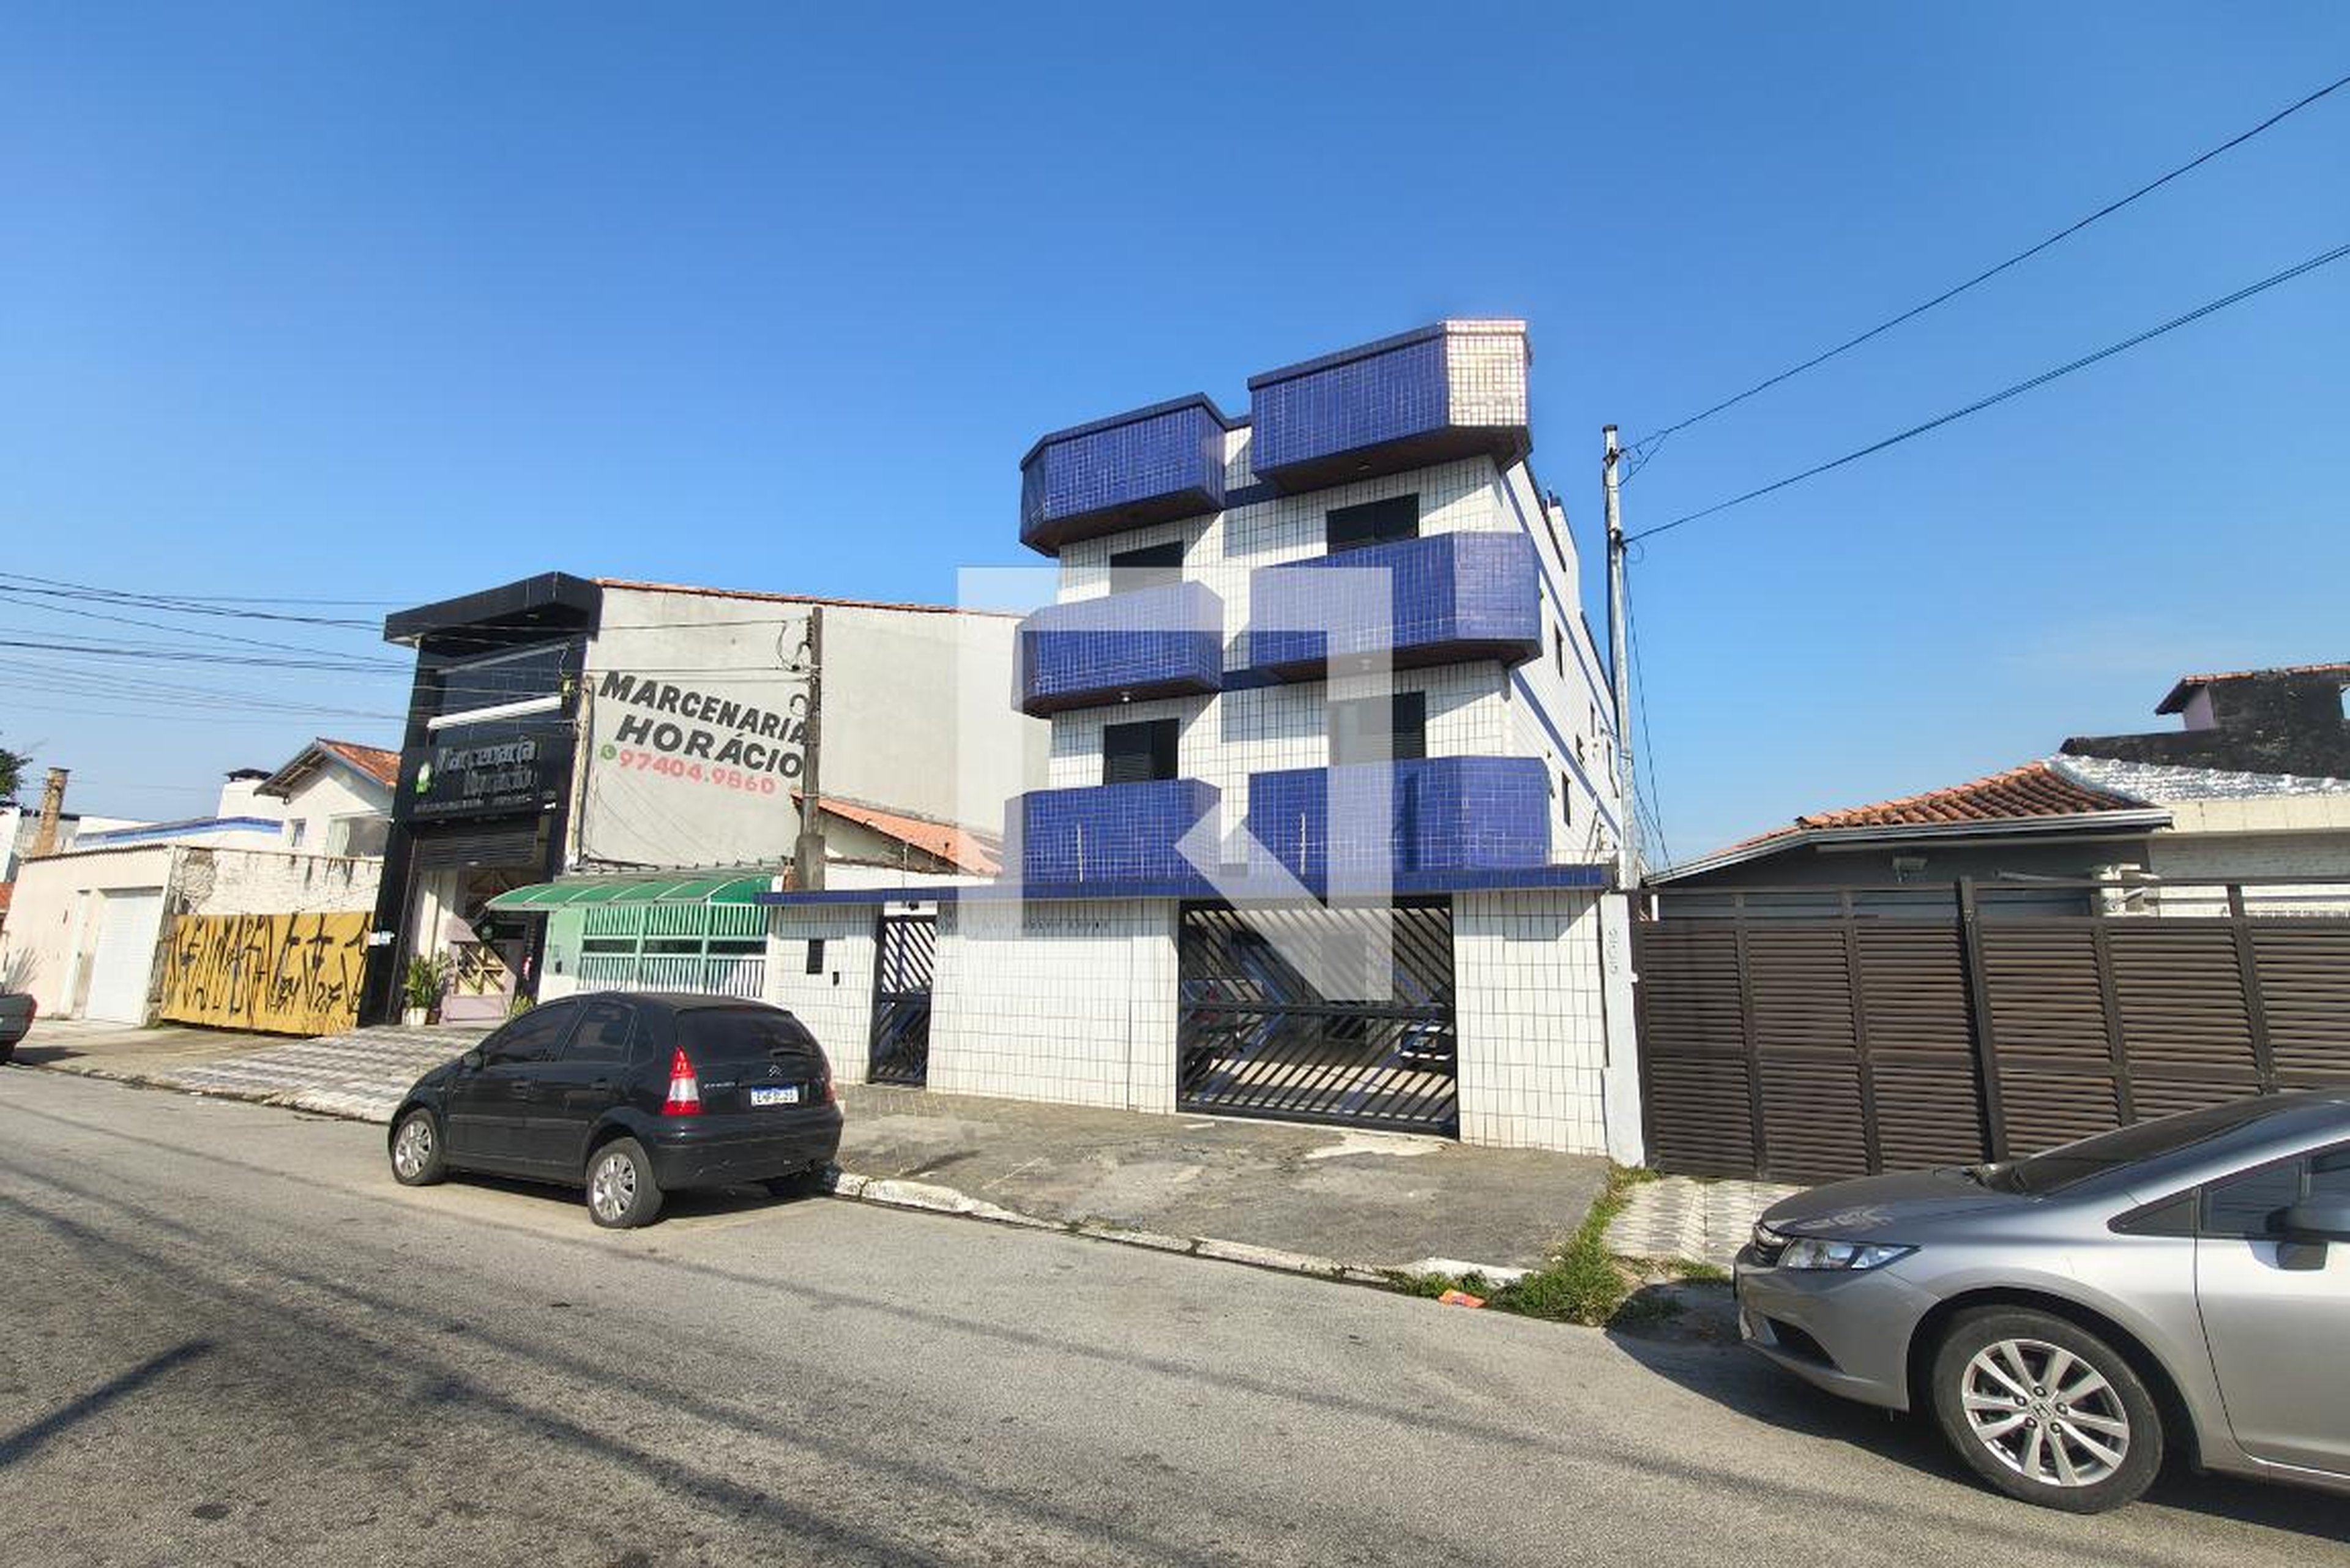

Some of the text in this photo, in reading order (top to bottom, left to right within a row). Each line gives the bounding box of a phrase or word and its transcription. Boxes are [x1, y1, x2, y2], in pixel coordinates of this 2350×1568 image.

[599, 671, 808, 746] MARCENARIA
[616, 714, 804, 778] HORÁCIO
[619, 749, 776, 795] 97404.9860
